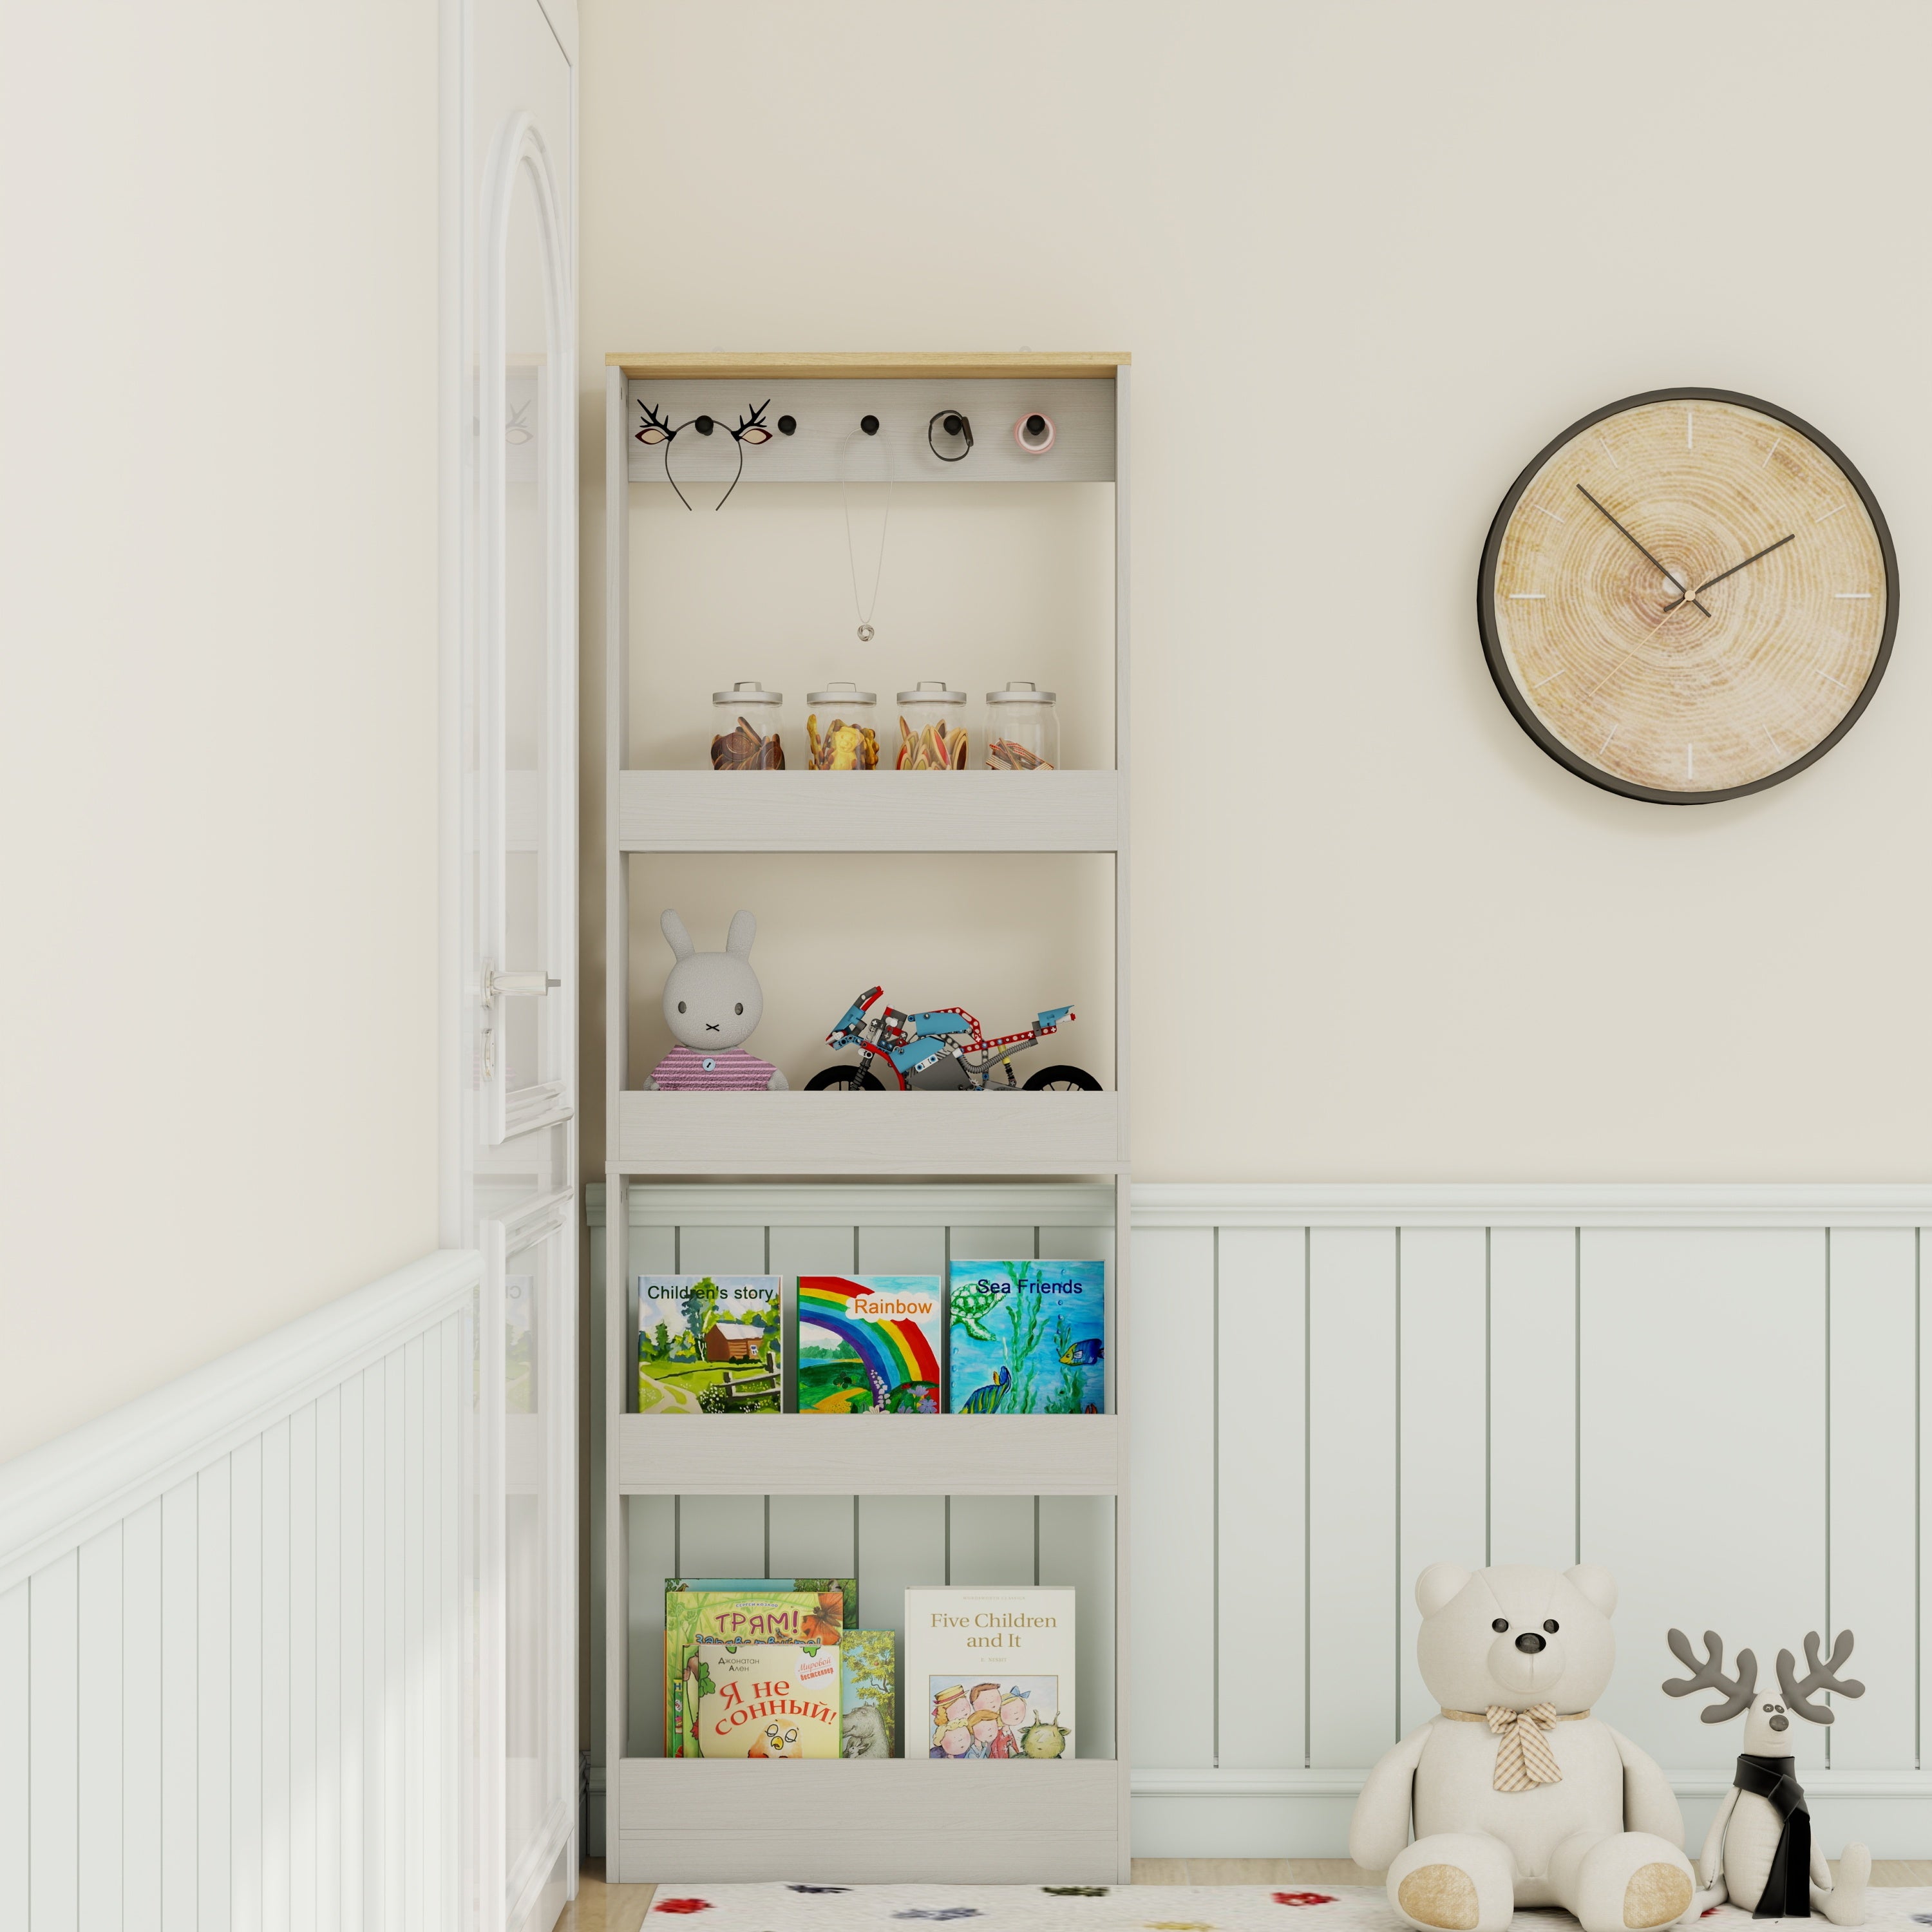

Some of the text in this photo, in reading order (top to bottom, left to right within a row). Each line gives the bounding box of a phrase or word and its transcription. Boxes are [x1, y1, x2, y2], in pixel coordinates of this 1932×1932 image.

[647, 1285, 773, 1303] Children's story
[978, 1279, 1083, 1294] Sea Friends
[855, 1299, 933, 1314] Rainbow
[715, 1610, 799, 1635] ТРЯМ!
[931, 1613, 1057, 1628] Five Children
[967, 1633, 1021, 1648] and It
[798, 1657, 832, 1672] Мировой
[800, 1667, 835, 1681] бестселлер
[719, 1680, 790, 1711] Я не
[715, 1699, 837, 1736] сонный!
